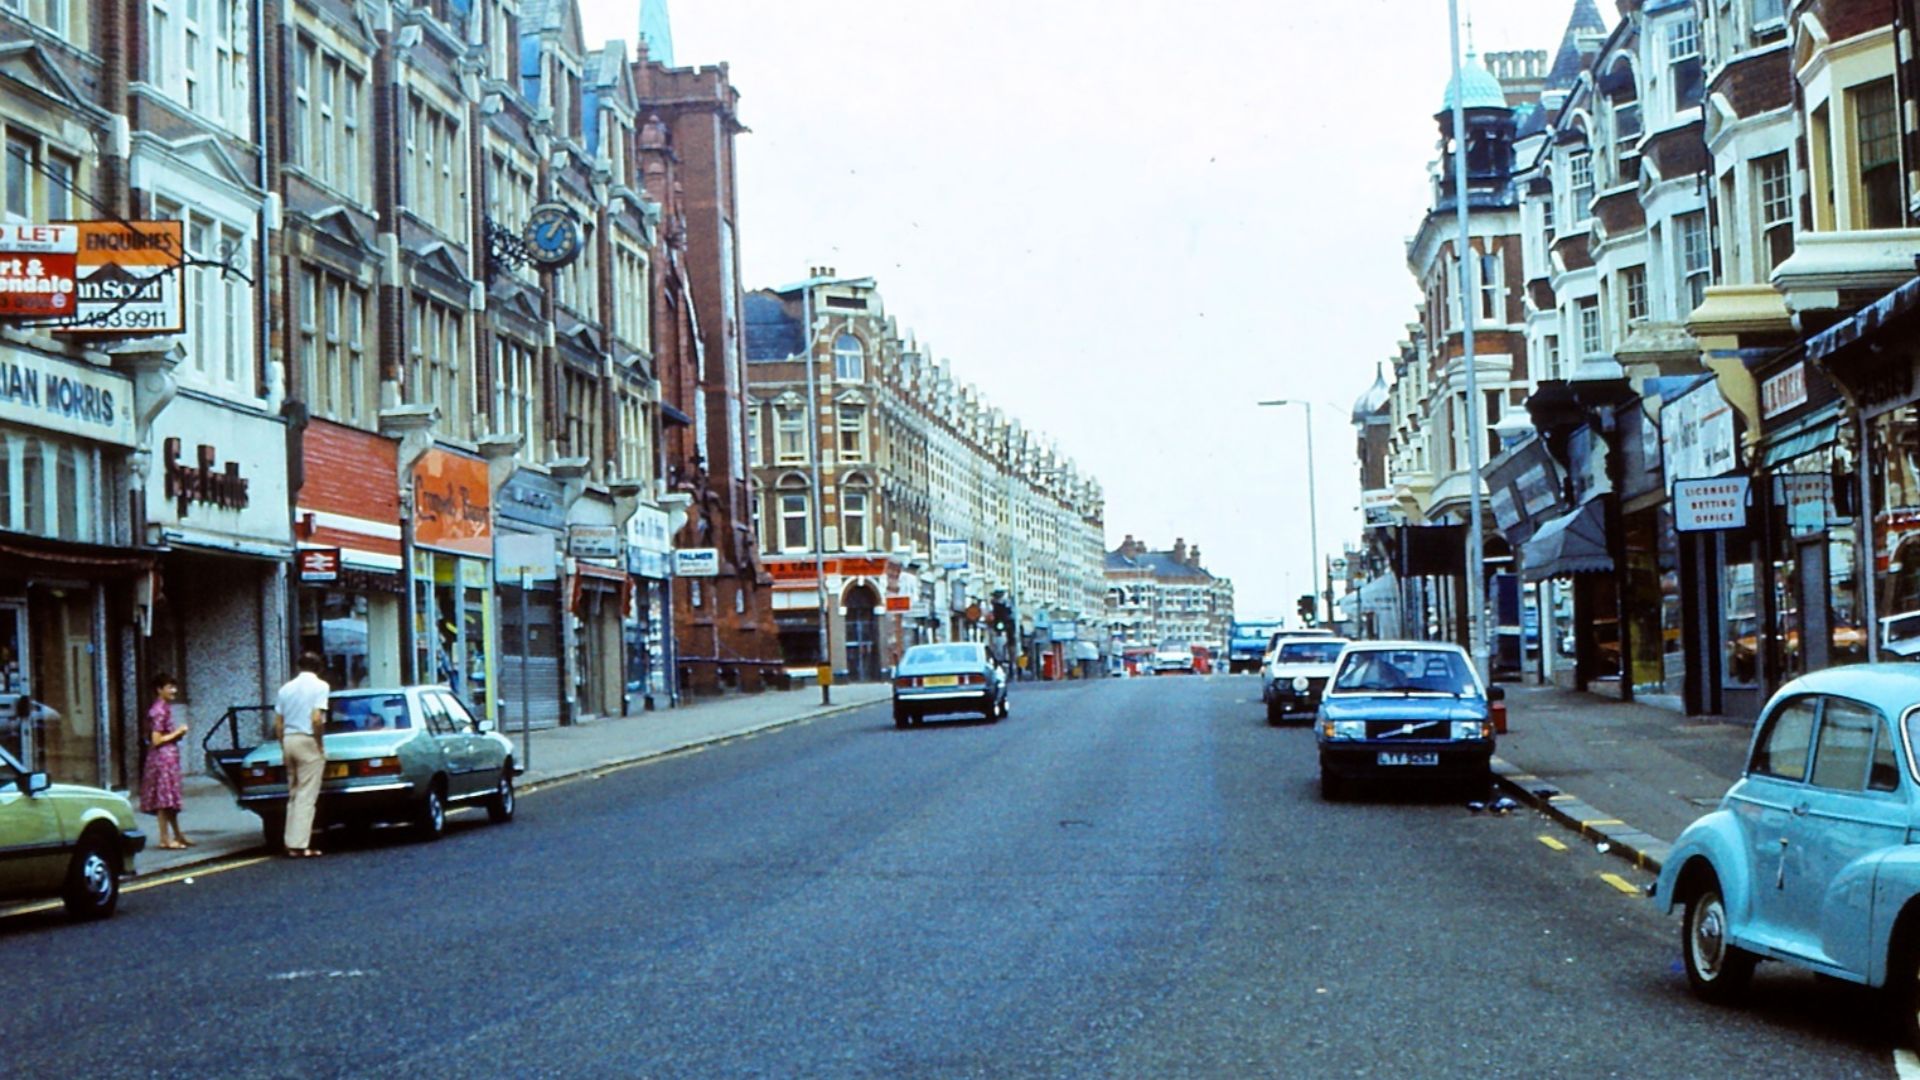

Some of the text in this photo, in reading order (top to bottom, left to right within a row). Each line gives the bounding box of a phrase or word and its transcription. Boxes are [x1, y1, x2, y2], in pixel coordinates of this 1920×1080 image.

[17, 226, 65, 242] LET
[26, 259, 45, 276] &
[125, 310, 166, 328] 9911
[46, 372, 115, 426] MORRIS
[1685, 484, 1740, 497] LICENSED
[1691, 499, 1737, 510] BETTING
[1695, 513, 1734, 524] OFFICE
